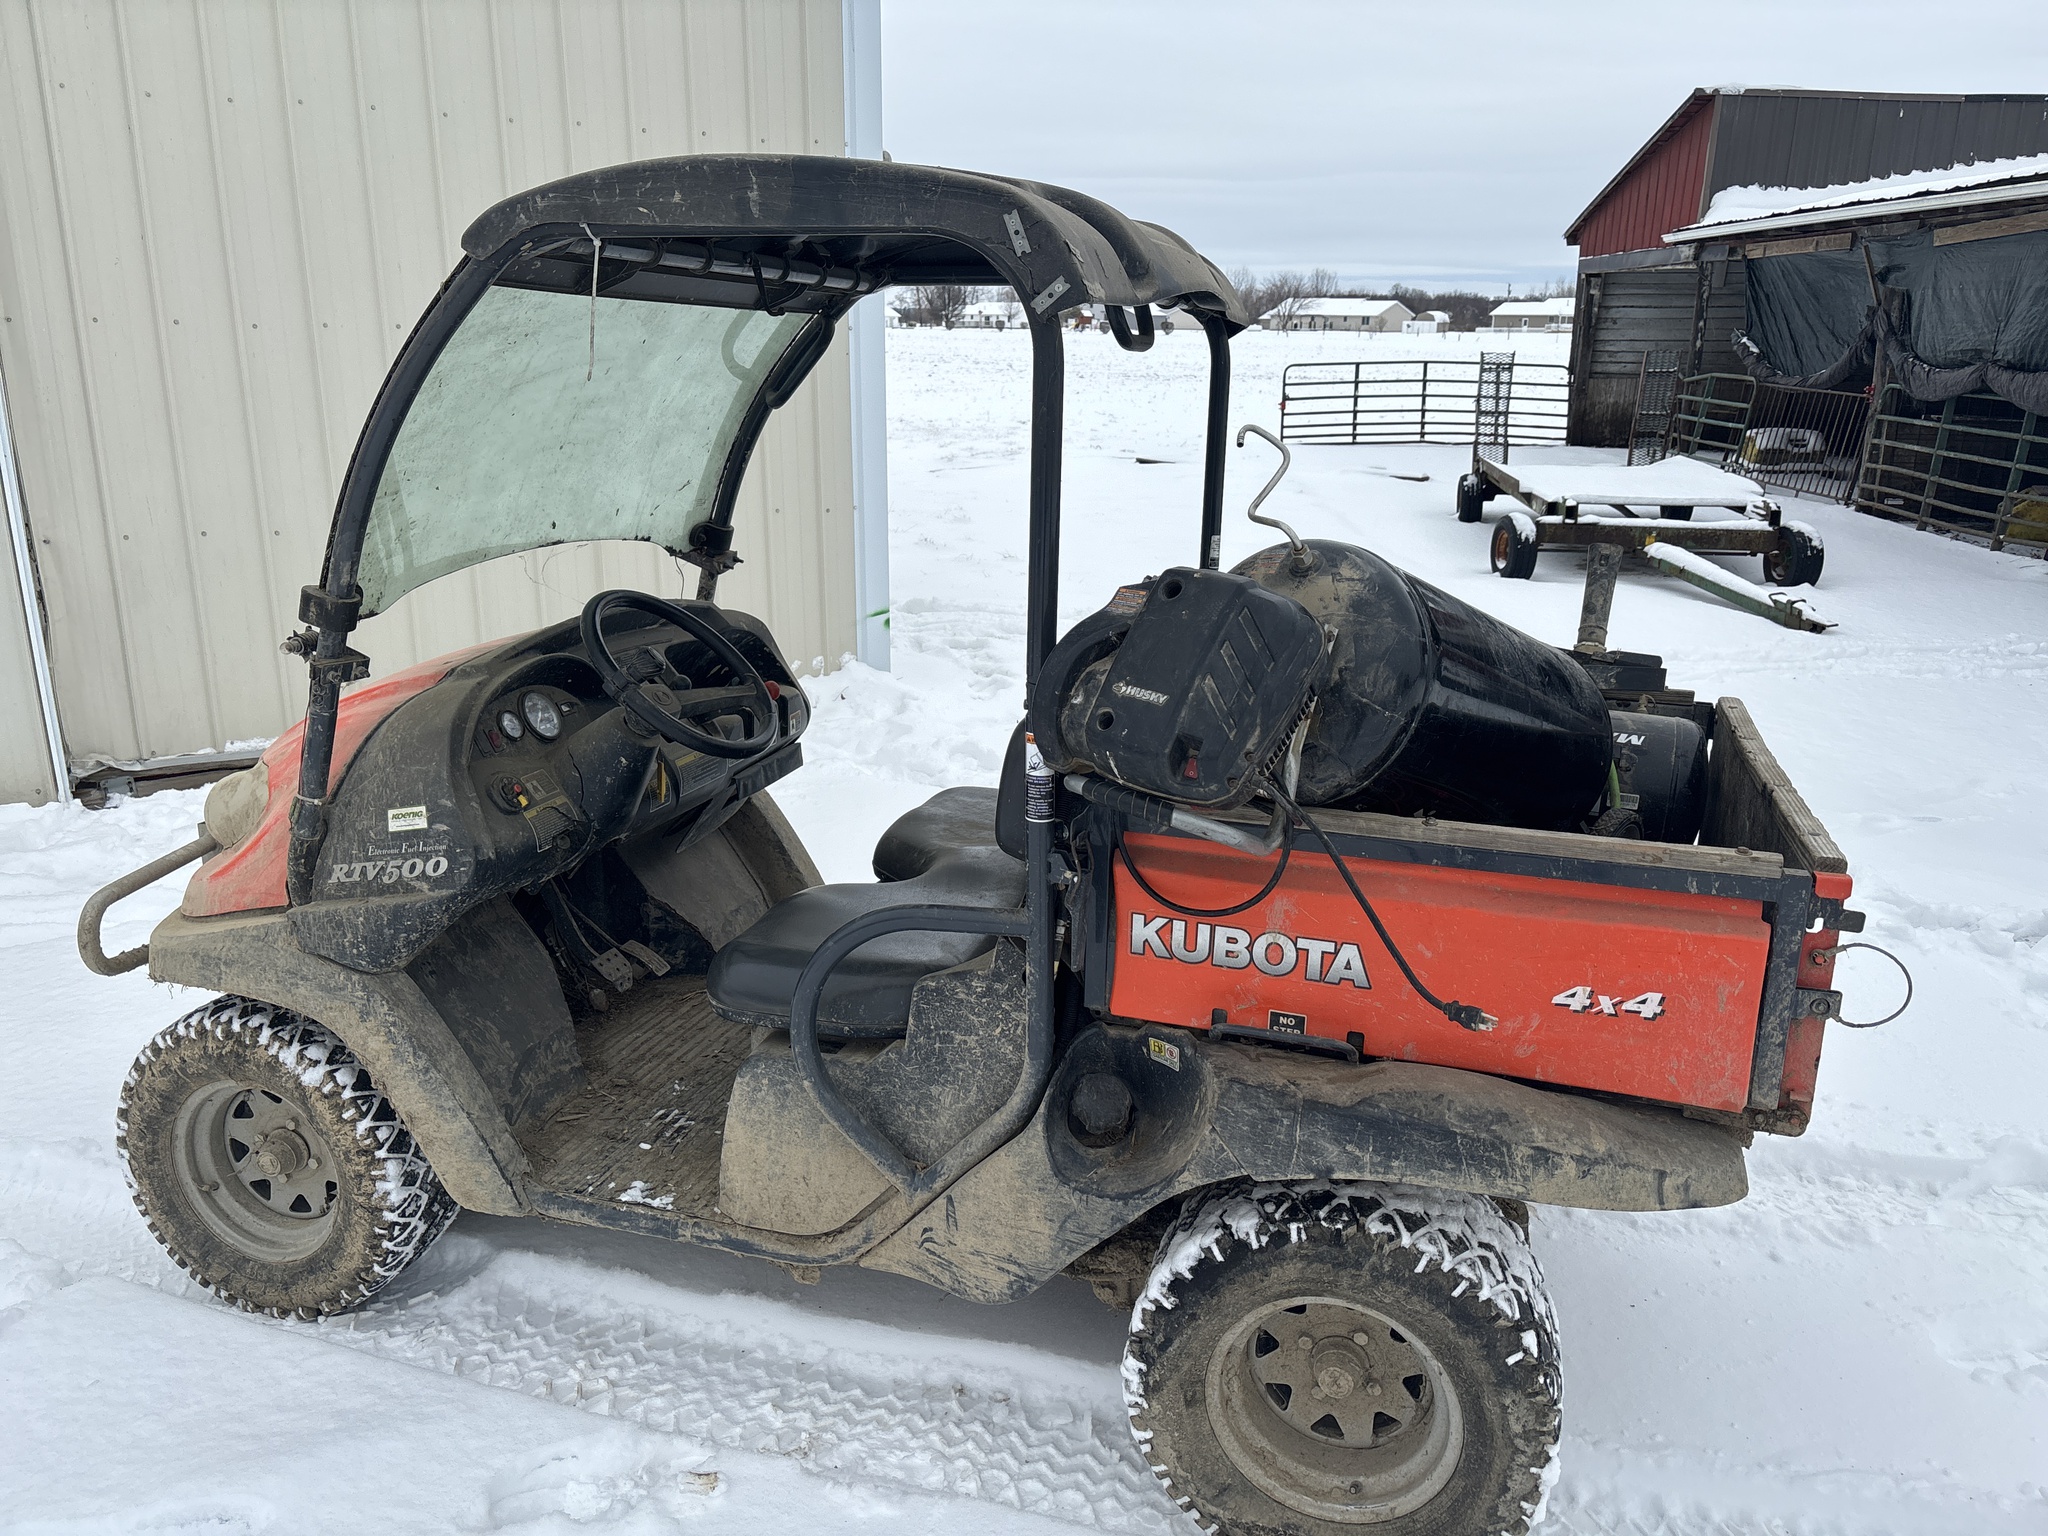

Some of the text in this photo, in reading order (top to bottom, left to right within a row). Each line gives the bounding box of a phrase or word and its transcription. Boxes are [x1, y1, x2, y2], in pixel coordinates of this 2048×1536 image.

[1126, 685, 1168, 704] HUSKY
[368, 841, 447, 856] Electronic Fuel Injection
[328, 856, 449, 884] RTV500
[1130, 911, 1372, 990] KUBOTA
[1551, 985, 1667, 1021] 4x4
[1279, 1015, 1296, 1026] NO
